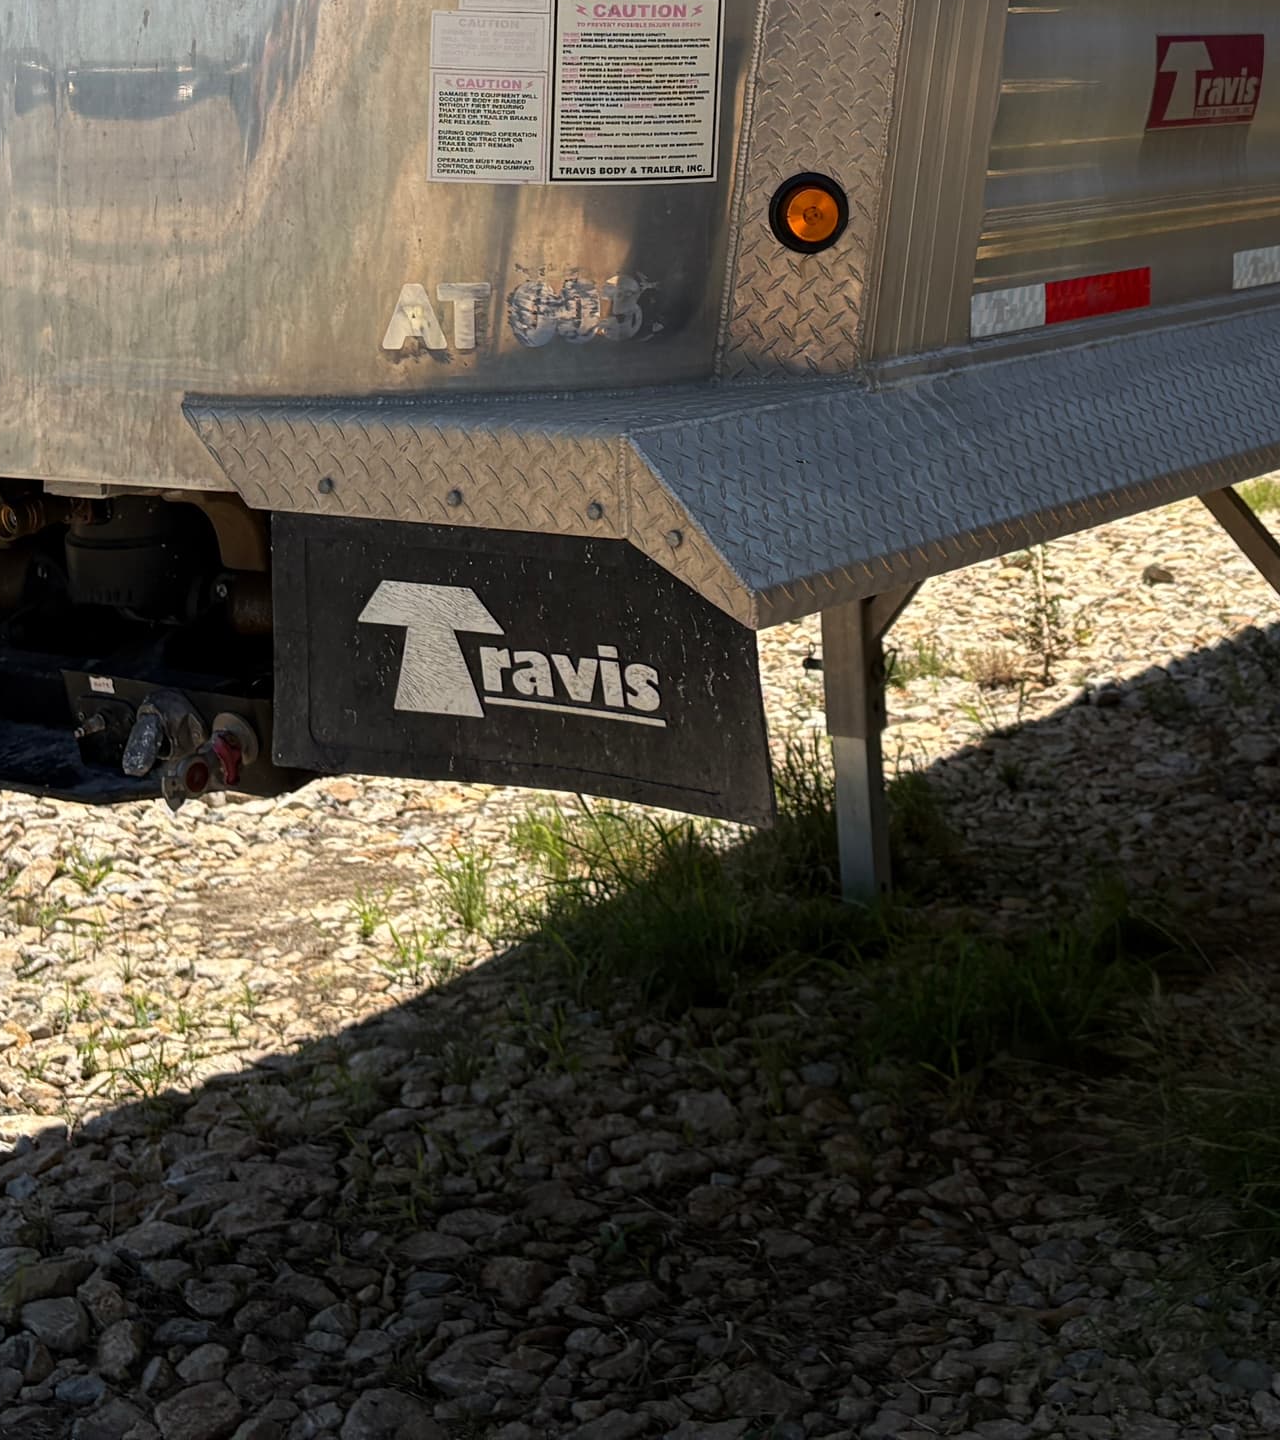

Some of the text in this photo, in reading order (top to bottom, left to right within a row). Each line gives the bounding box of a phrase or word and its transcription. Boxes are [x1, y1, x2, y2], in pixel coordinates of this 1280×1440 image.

[593, 4, 687, 18] CAUTION
[458, 18, 520, 29] CAUTION
[456, 78, 523, 89] CAUTION
[1159, 41, 1259, 121] Travis
[559, 164, 706, 175] TRAVIS BODY & TRAILER, INC.
[382, 282, 491, 350] AT
[358, 580, 662, 718] Travis
